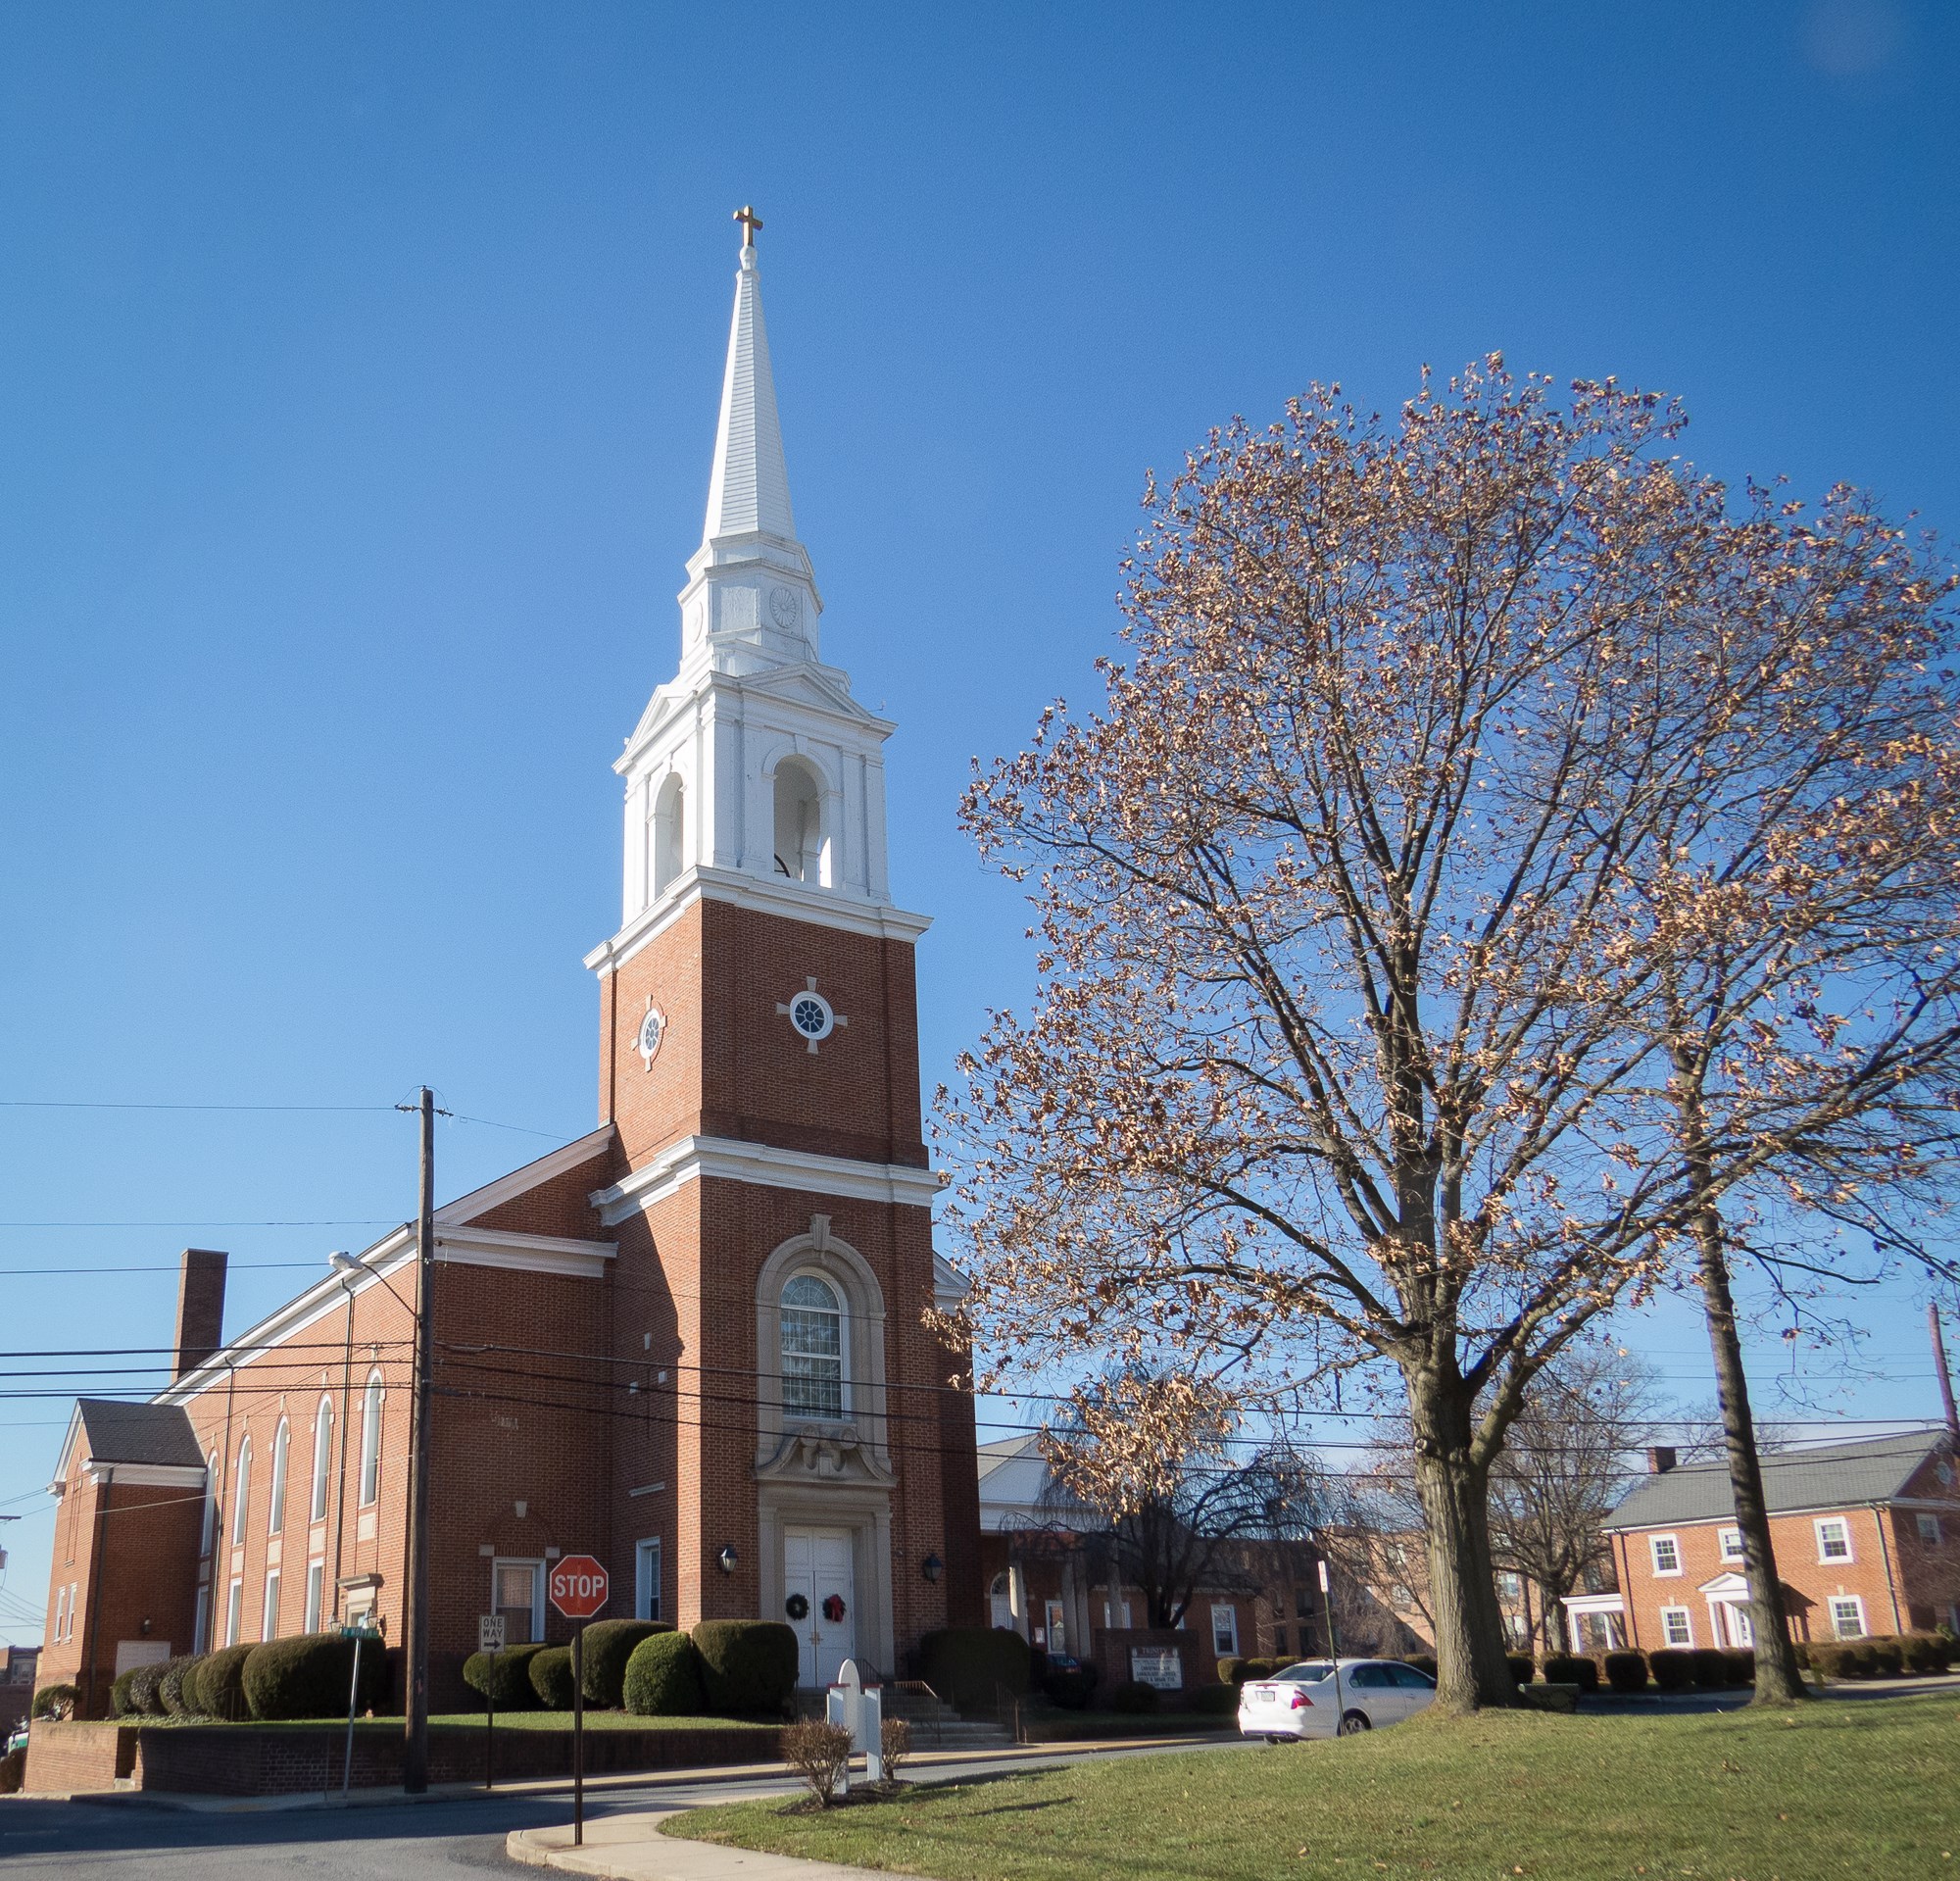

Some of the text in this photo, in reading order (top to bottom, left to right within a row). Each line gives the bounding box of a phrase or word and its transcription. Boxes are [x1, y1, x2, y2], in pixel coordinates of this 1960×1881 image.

[554, 1575, 605, 1598] STOP
[483, 1617, 503, 1628] ONE
[483, 1628, 503, 1638] WAY
